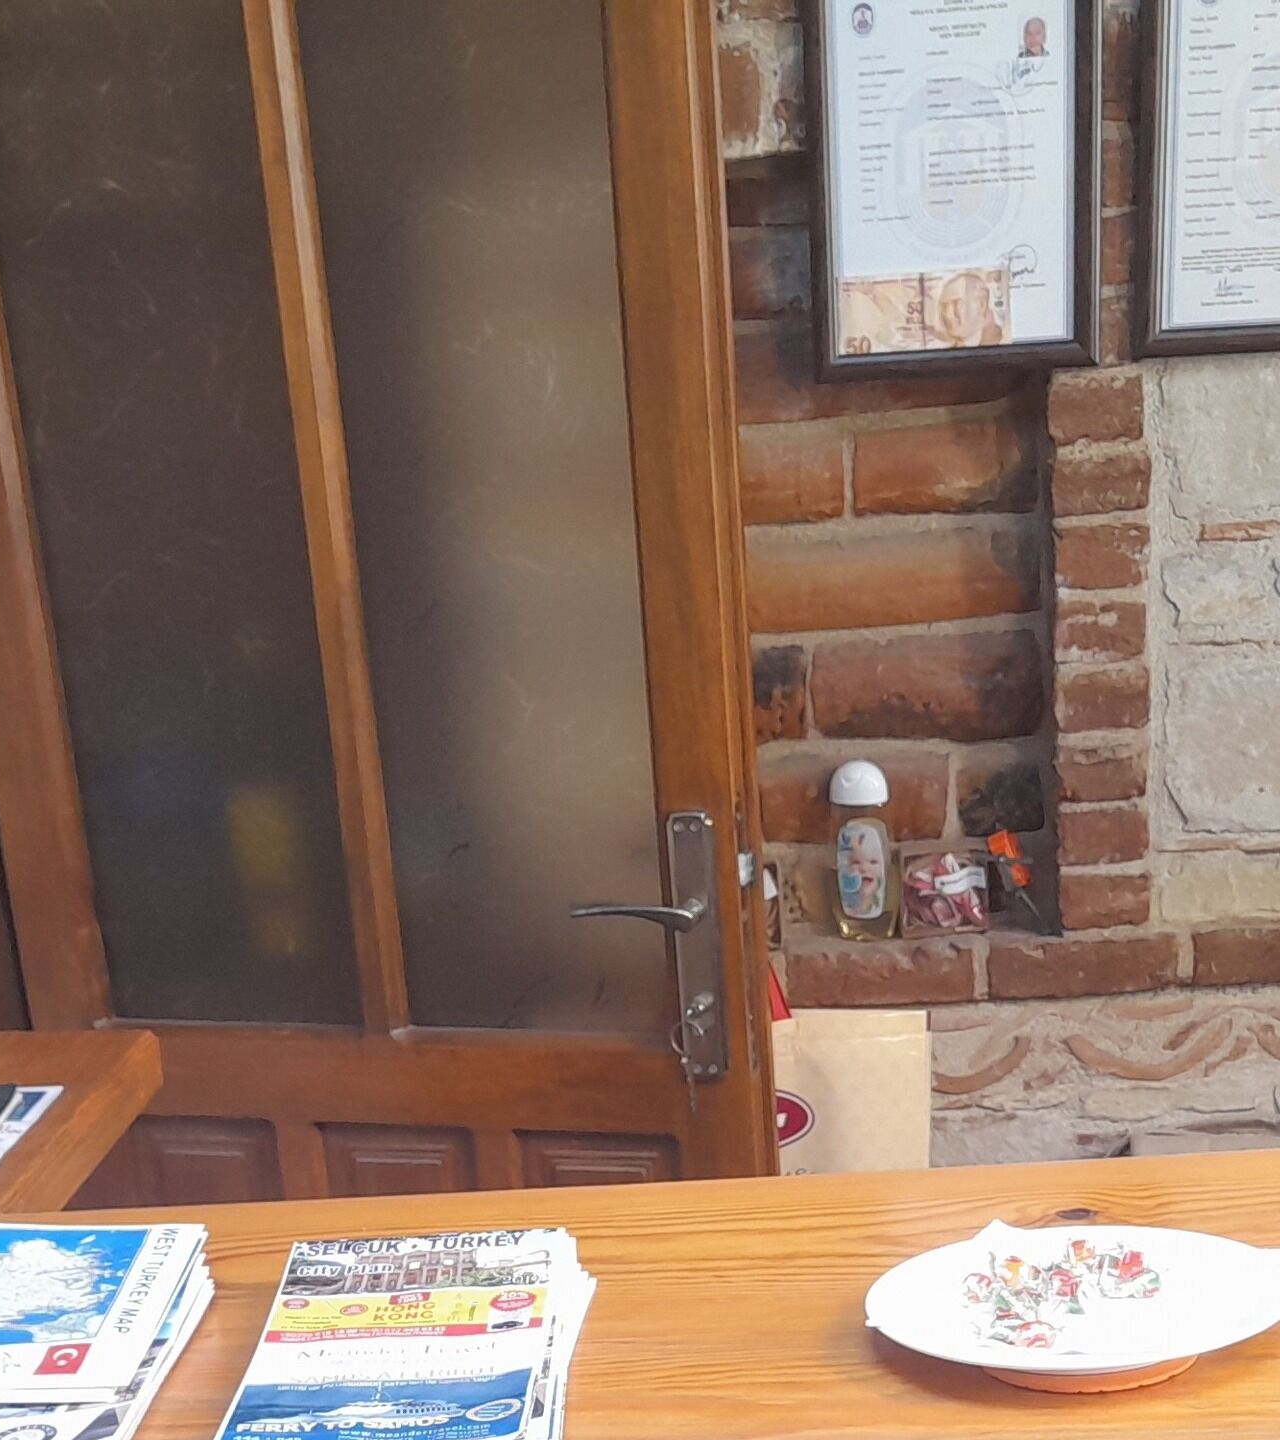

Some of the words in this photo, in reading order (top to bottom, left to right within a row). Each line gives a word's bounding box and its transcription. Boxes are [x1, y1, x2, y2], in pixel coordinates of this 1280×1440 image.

[156, 1227, 182, 1258] WEST
[297, 1264, 340, 1278] City
[344, 1262, 395, 1276] Plan
[129, 1260, 163, 1305] TURKEY
[372, 1311, 434, 1322] KONG
[375, 1301, 436, 1313] HONG
[113, 1307, 141, 1335] MAP
[235, 1421, 313, 1434] FERRY
[323, 1419, 356, 1431] TO
[362, 1415, 451, 1431] SAMOS
